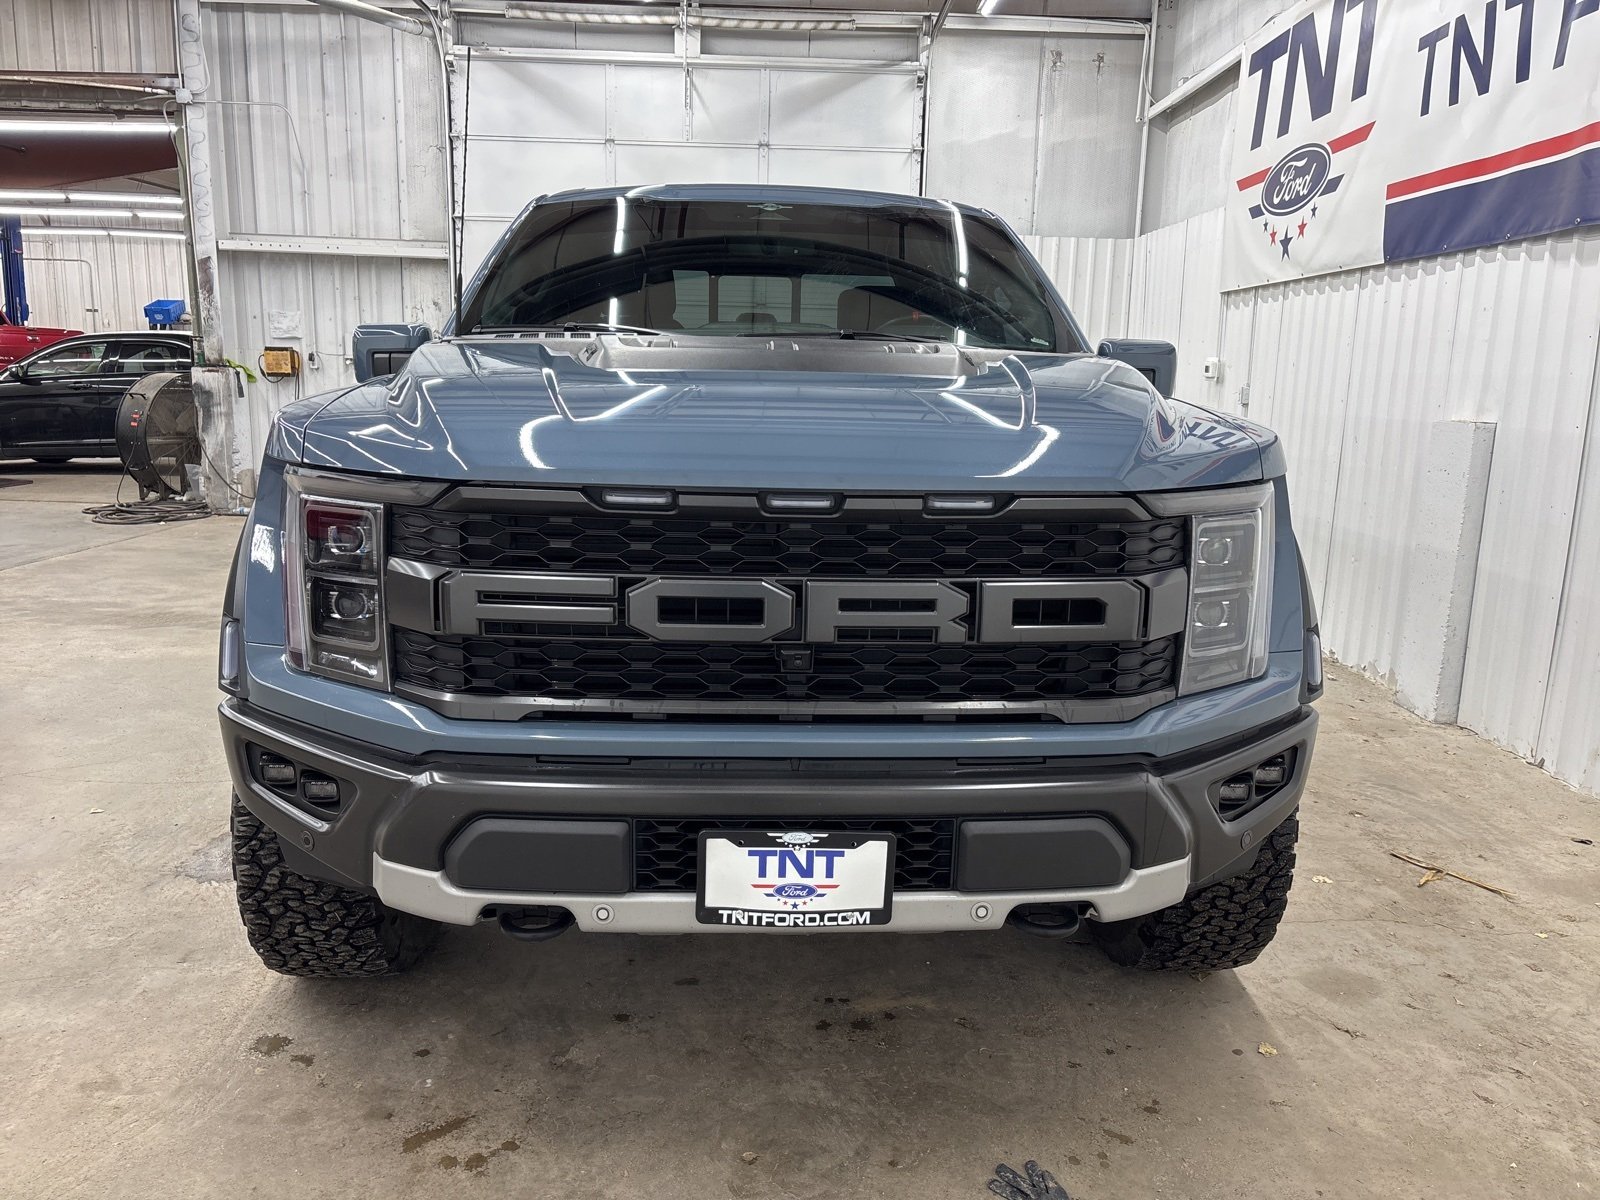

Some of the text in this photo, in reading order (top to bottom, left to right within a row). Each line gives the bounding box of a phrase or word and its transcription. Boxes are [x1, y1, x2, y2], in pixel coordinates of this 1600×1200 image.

[1248, 0, 1378, 151] TNT
[1418, 0, 1534, 117] TNT
[1273, 157, 1316, 205] Ford
[448, 571, 1145, 643] FORD
[748, 850, 845, 878] TNT
[782, 885, 809, 896] Ford
[718, 910, 870, 926] TNTFORD.COM
